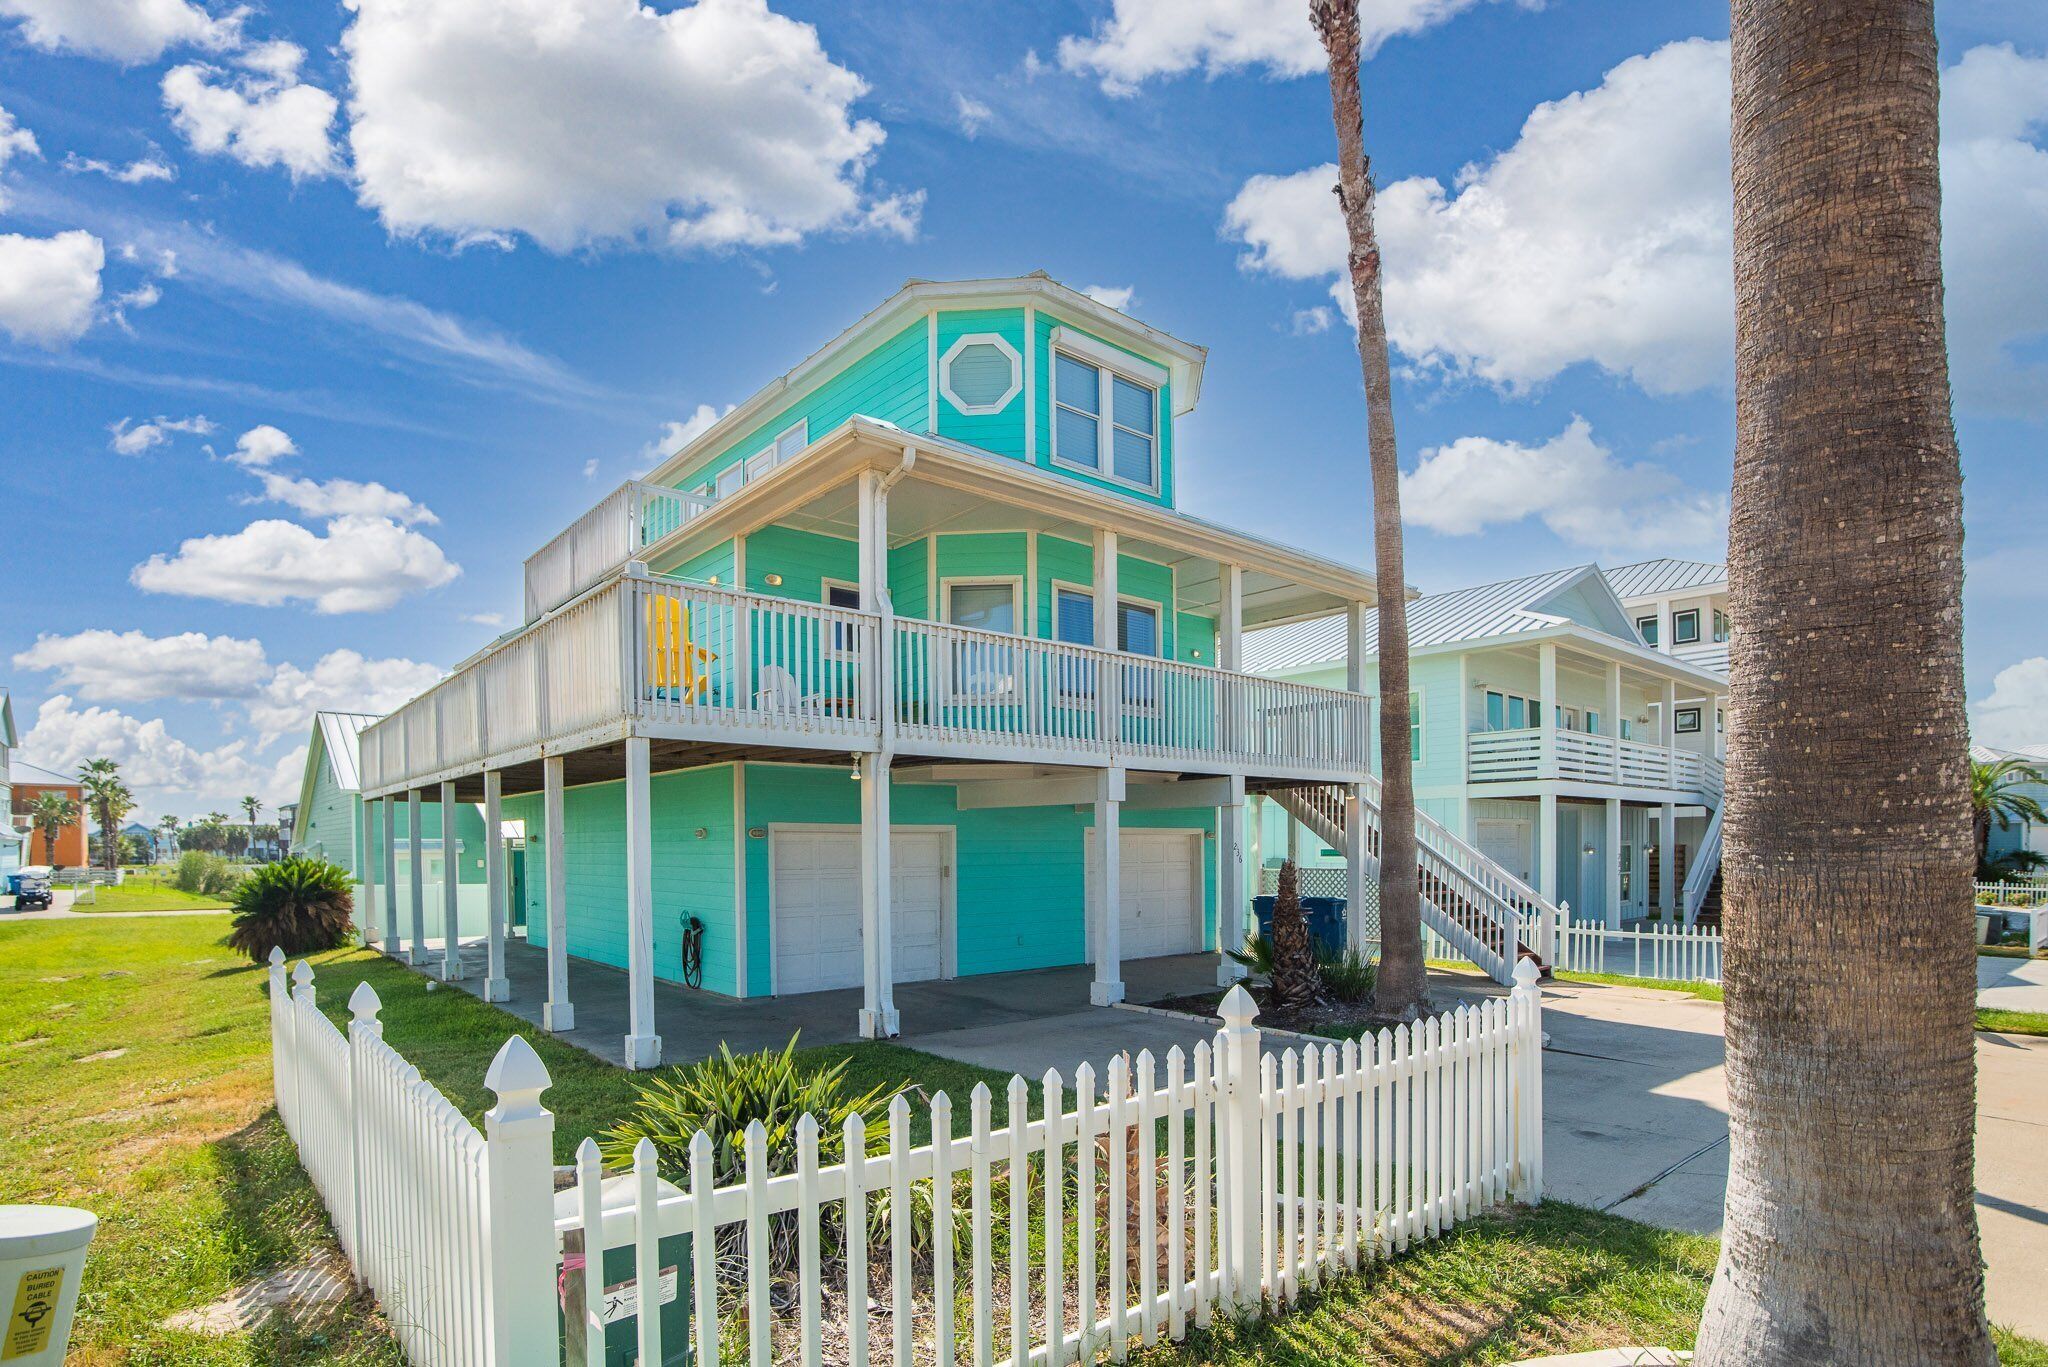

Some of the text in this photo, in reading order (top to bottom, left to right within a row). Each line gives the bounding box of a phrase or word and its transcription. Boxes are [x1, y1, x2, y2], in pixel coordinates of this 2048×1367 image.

[1233, 842, 1243, 863] 236
[27, 1270, 59, 1281] CAUTION
[27, 1280, 55, 1291] BURIED
[27, 1290, 52, 1300] CABLE
